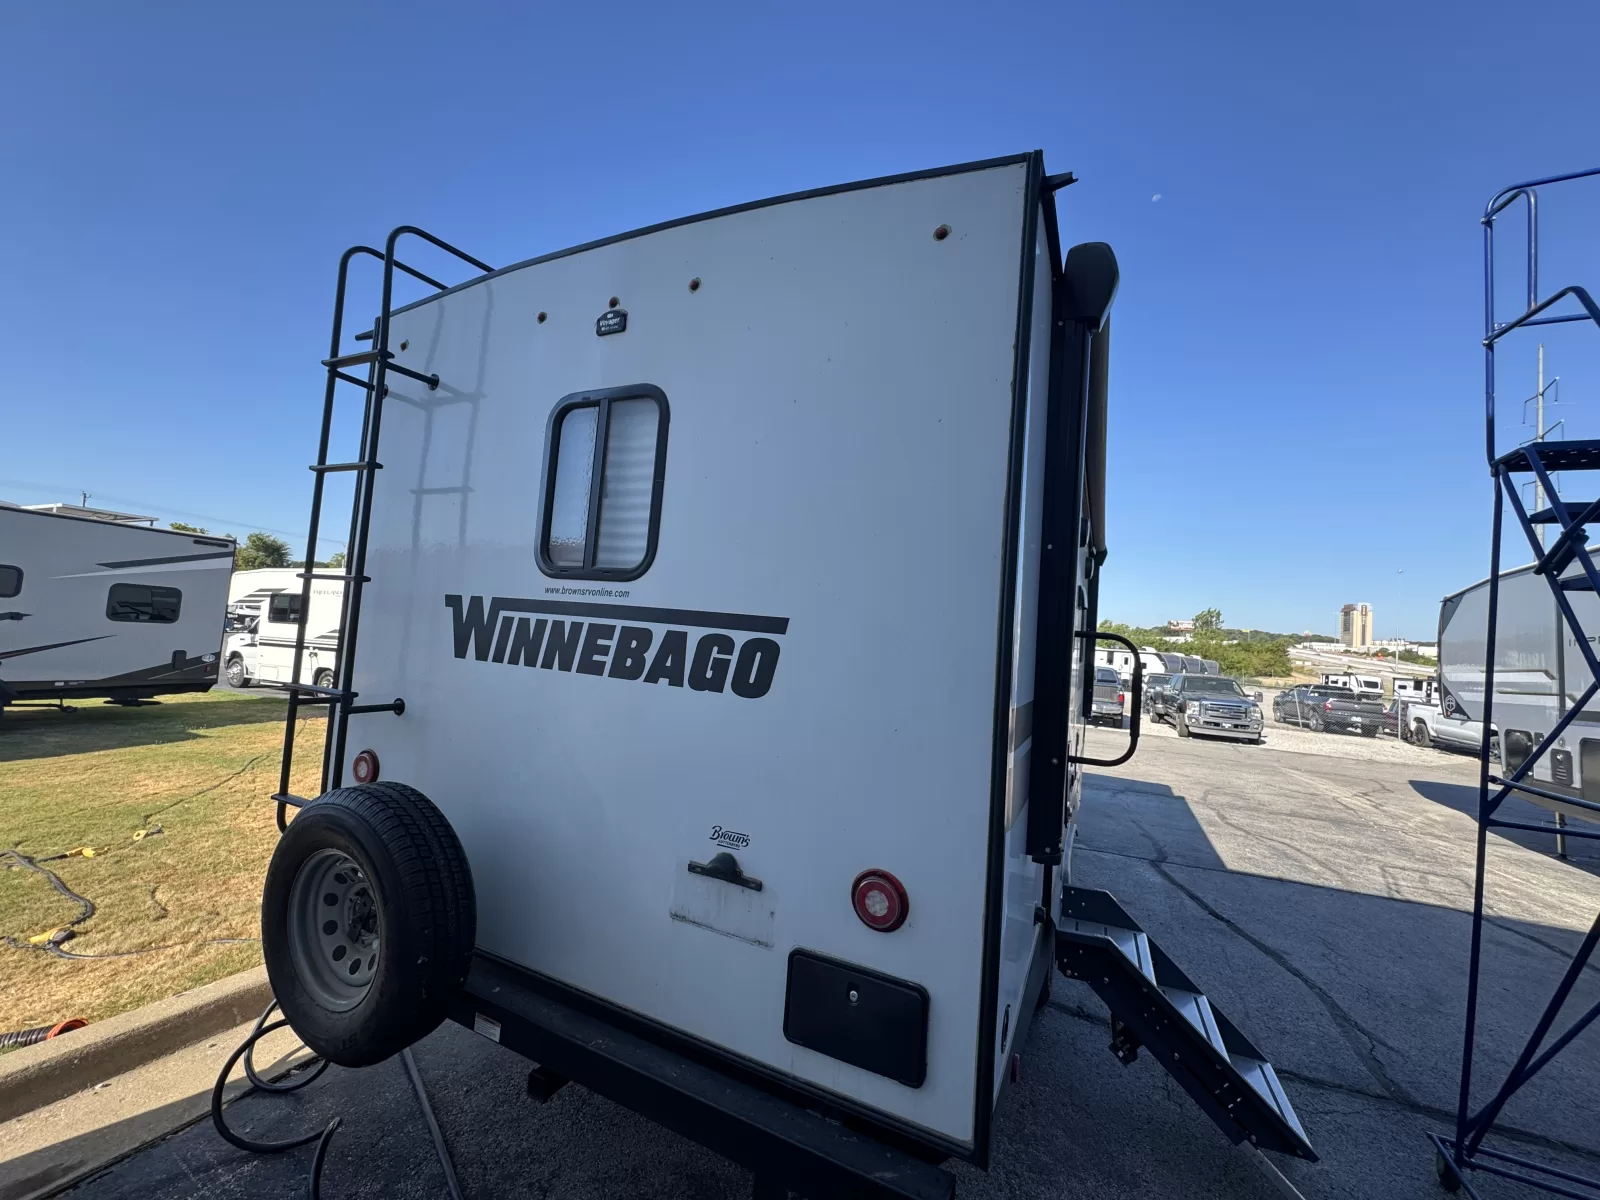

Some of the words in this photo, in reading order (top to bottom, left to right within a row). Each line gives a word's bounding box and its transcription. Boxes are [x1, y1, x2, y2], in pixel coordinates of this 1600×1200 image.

[544, 586, 630, 598] www.brownsrvonline.com
[445, 594, 790, 699] WINNEBAGO
[709, 825, 751, 848] Brown's
